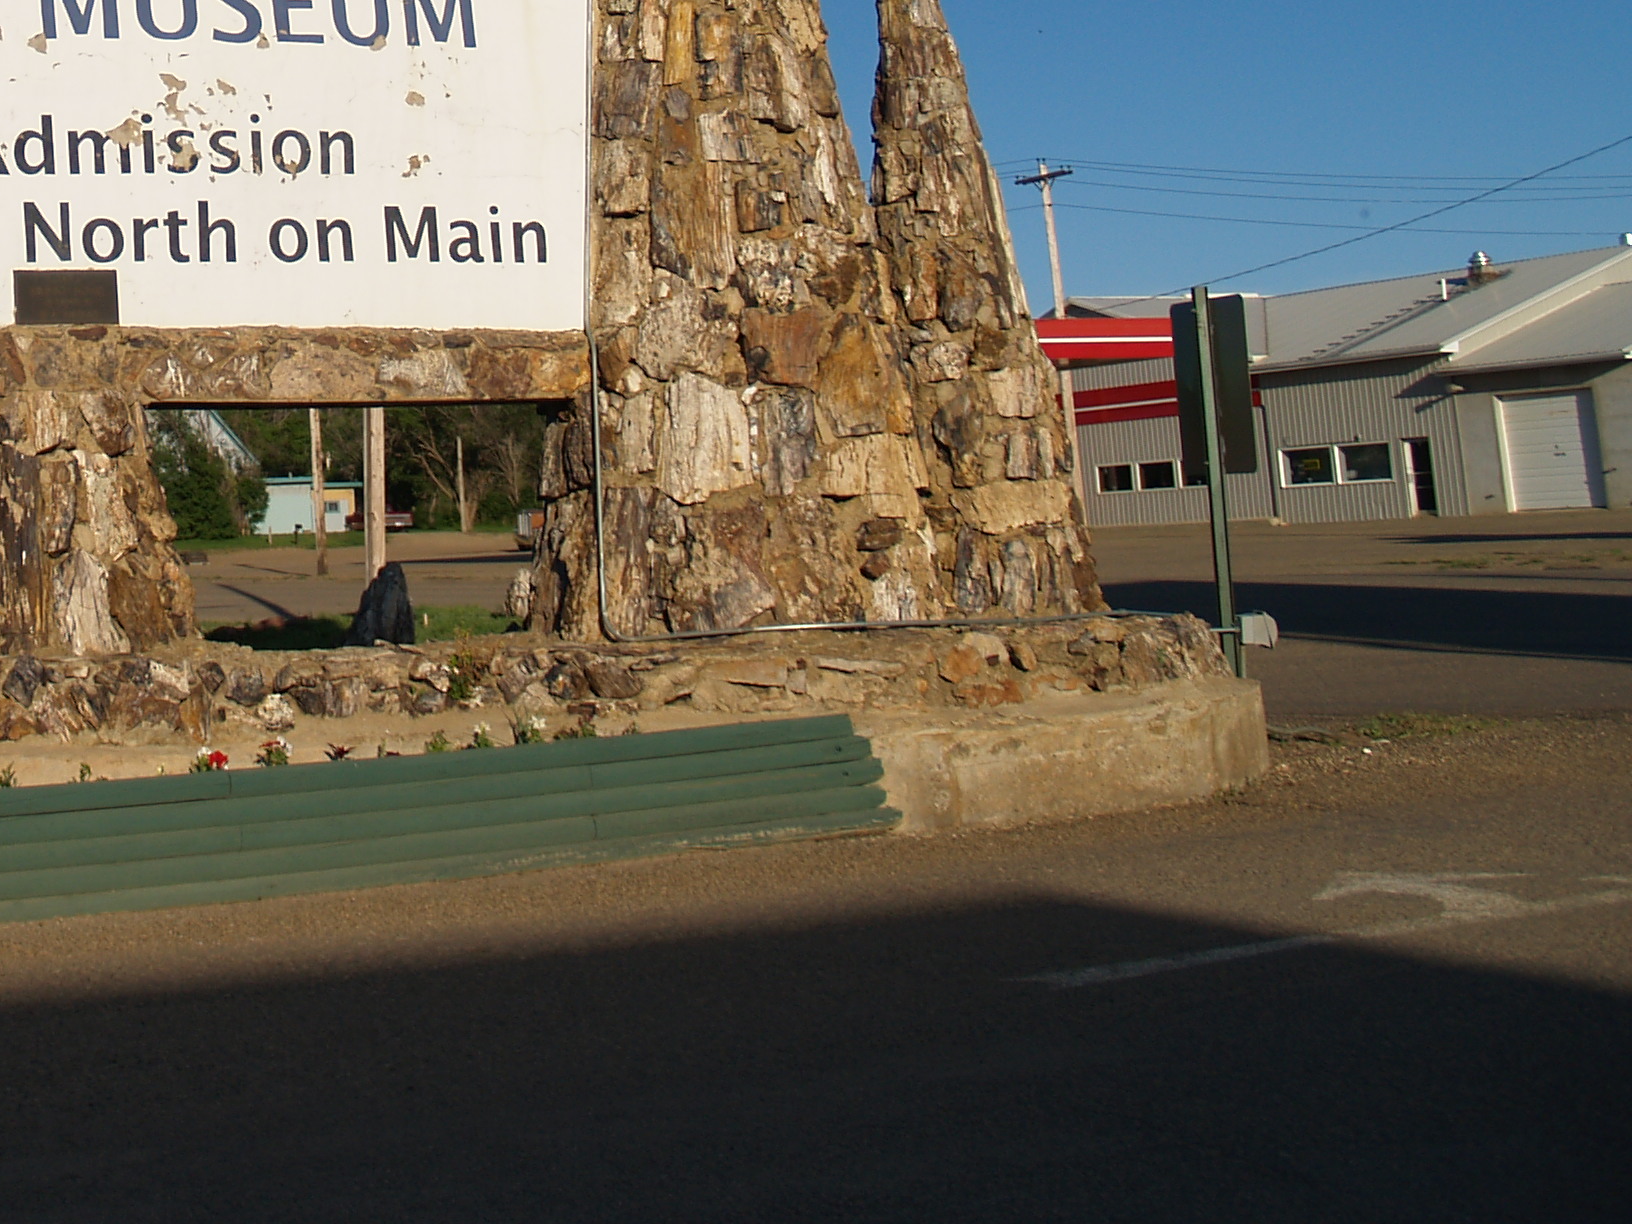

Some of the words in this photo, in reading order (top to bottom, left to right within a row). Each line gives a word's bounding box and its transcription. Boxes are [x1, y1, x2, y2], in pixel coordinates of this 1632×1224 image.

[24, 201, 237, 263] North
[269, 219, 355, 263] on
[384, 206, 547, 264] Main
